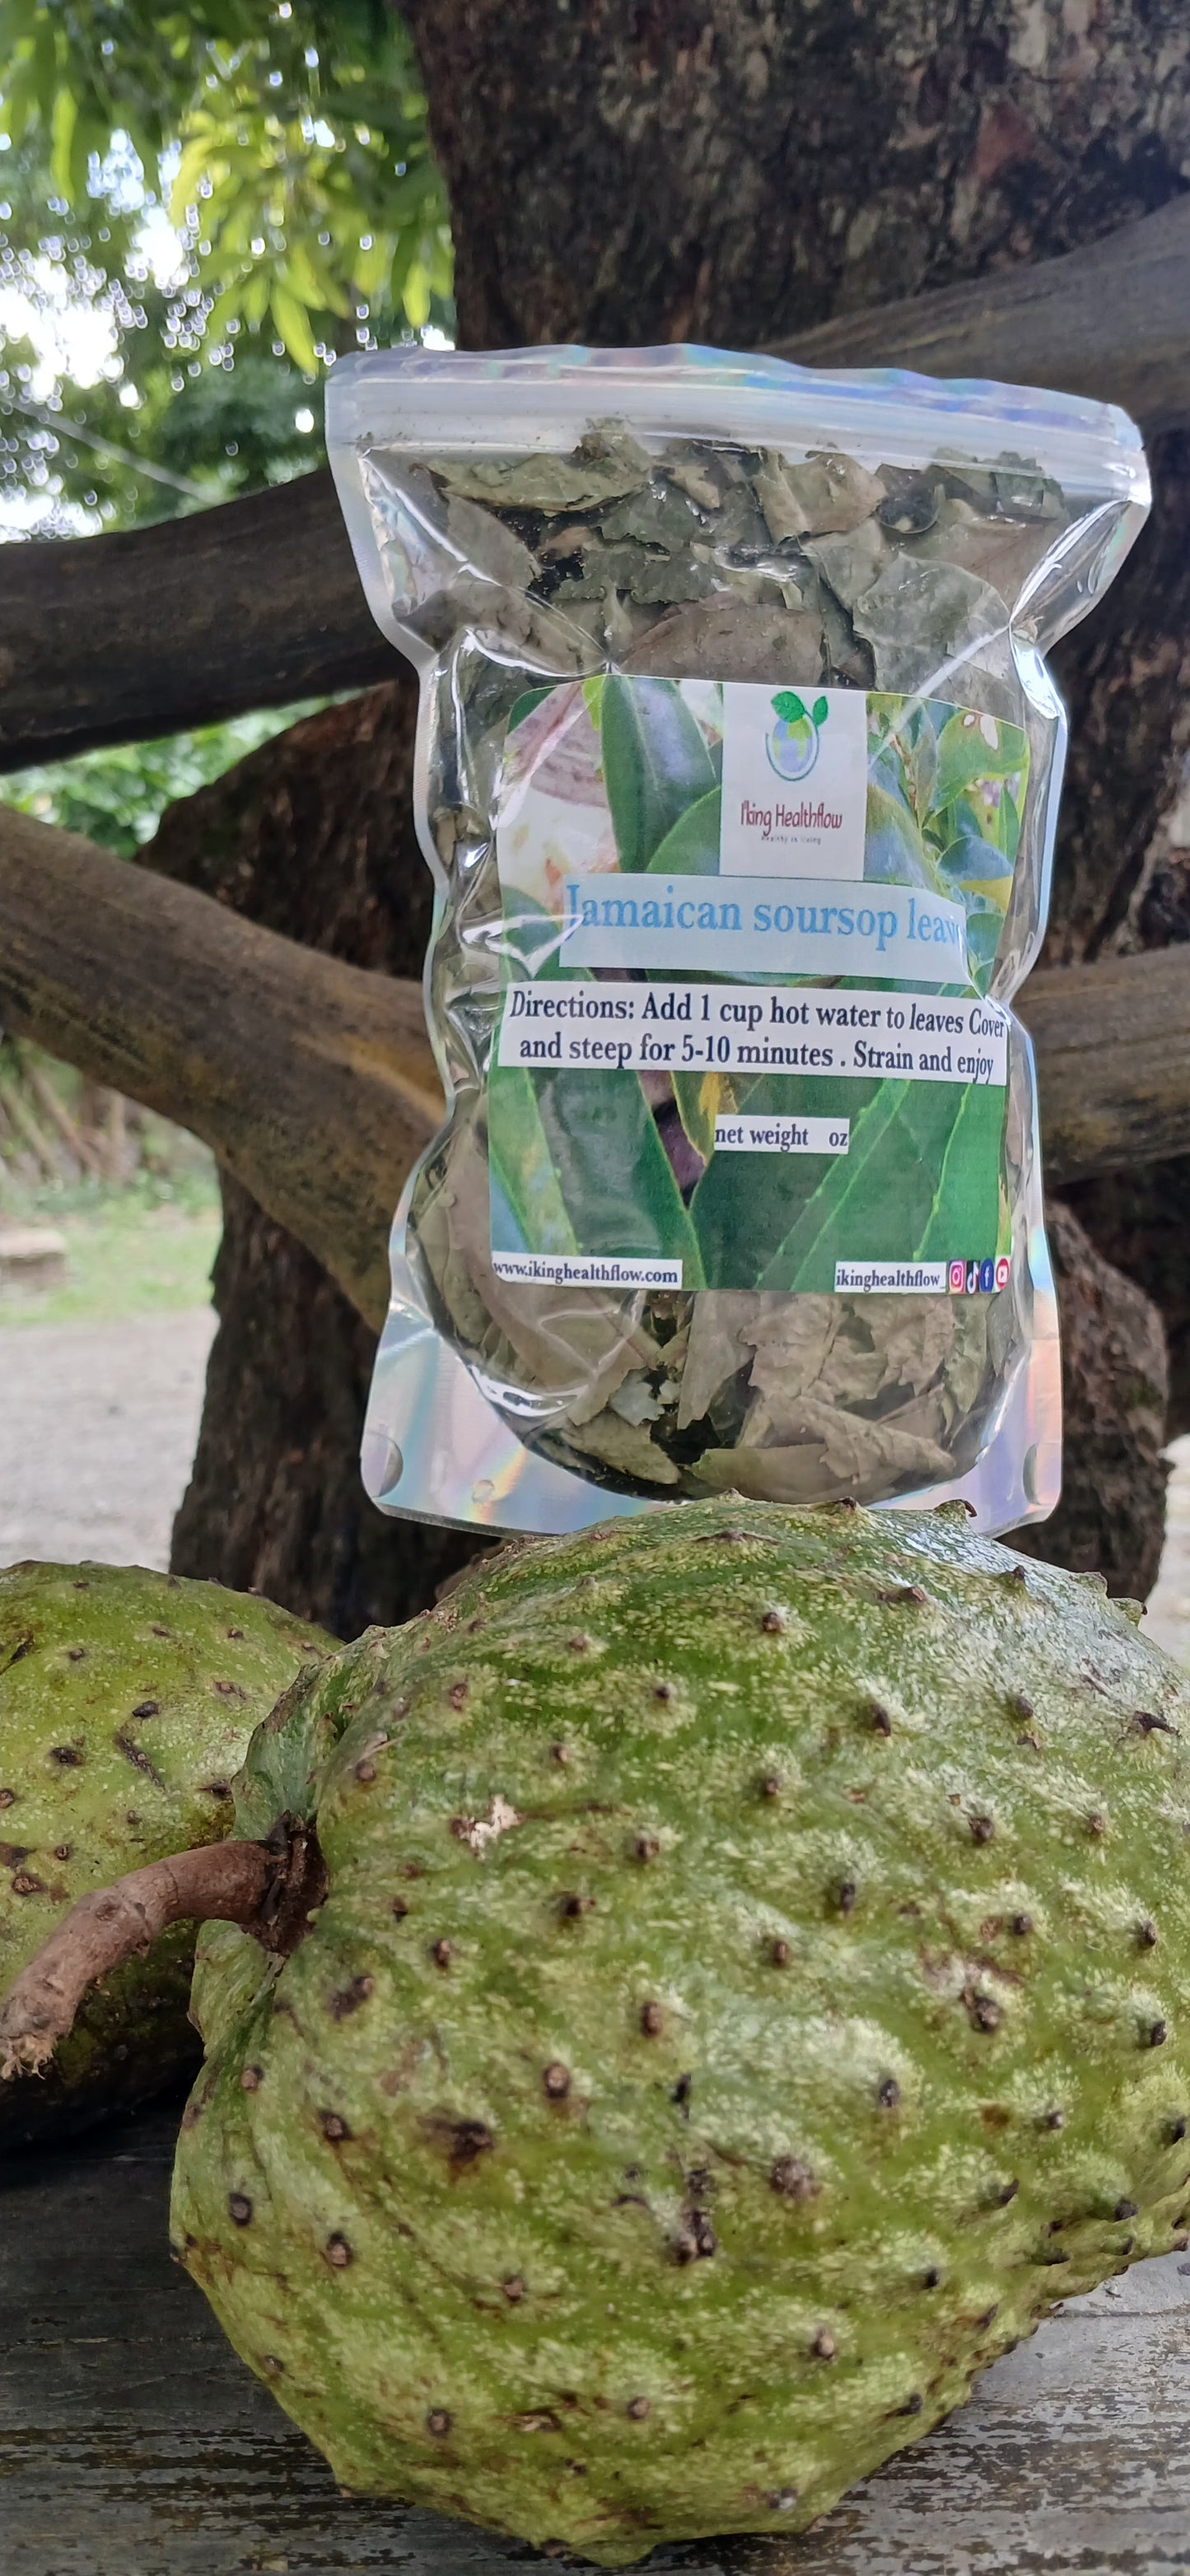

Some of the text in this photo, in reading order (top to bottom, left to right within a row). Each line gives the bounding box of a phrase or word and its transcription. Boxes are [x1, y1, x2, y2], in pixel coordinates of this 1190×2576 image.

[775, 802, 843, 829] Healthflow
[563, 883, 742, 943] Jamaican
[753, 902, 898, 951] soursop
[509, 990, 1006, 1038] Directions: Add 1 cup hot water to leaves Cover
[520, 1031, 562, 1059] and
[568, 1037, 632, 1069] steep
[639, 1033, 675, 1061] for
[680, 1033, 730, 1064] 5-10
[736, 1036, 833, 1068] minutes
[853, 1039, 915, 1071] Strain
[918, 1046, 952, 1074] and
[957, 1047, 995, 1083] enjoy
[715, 1122, 848, 1153] net weight oz
[493, 1260, 679, 1284] www.ikinghealthflow.com
